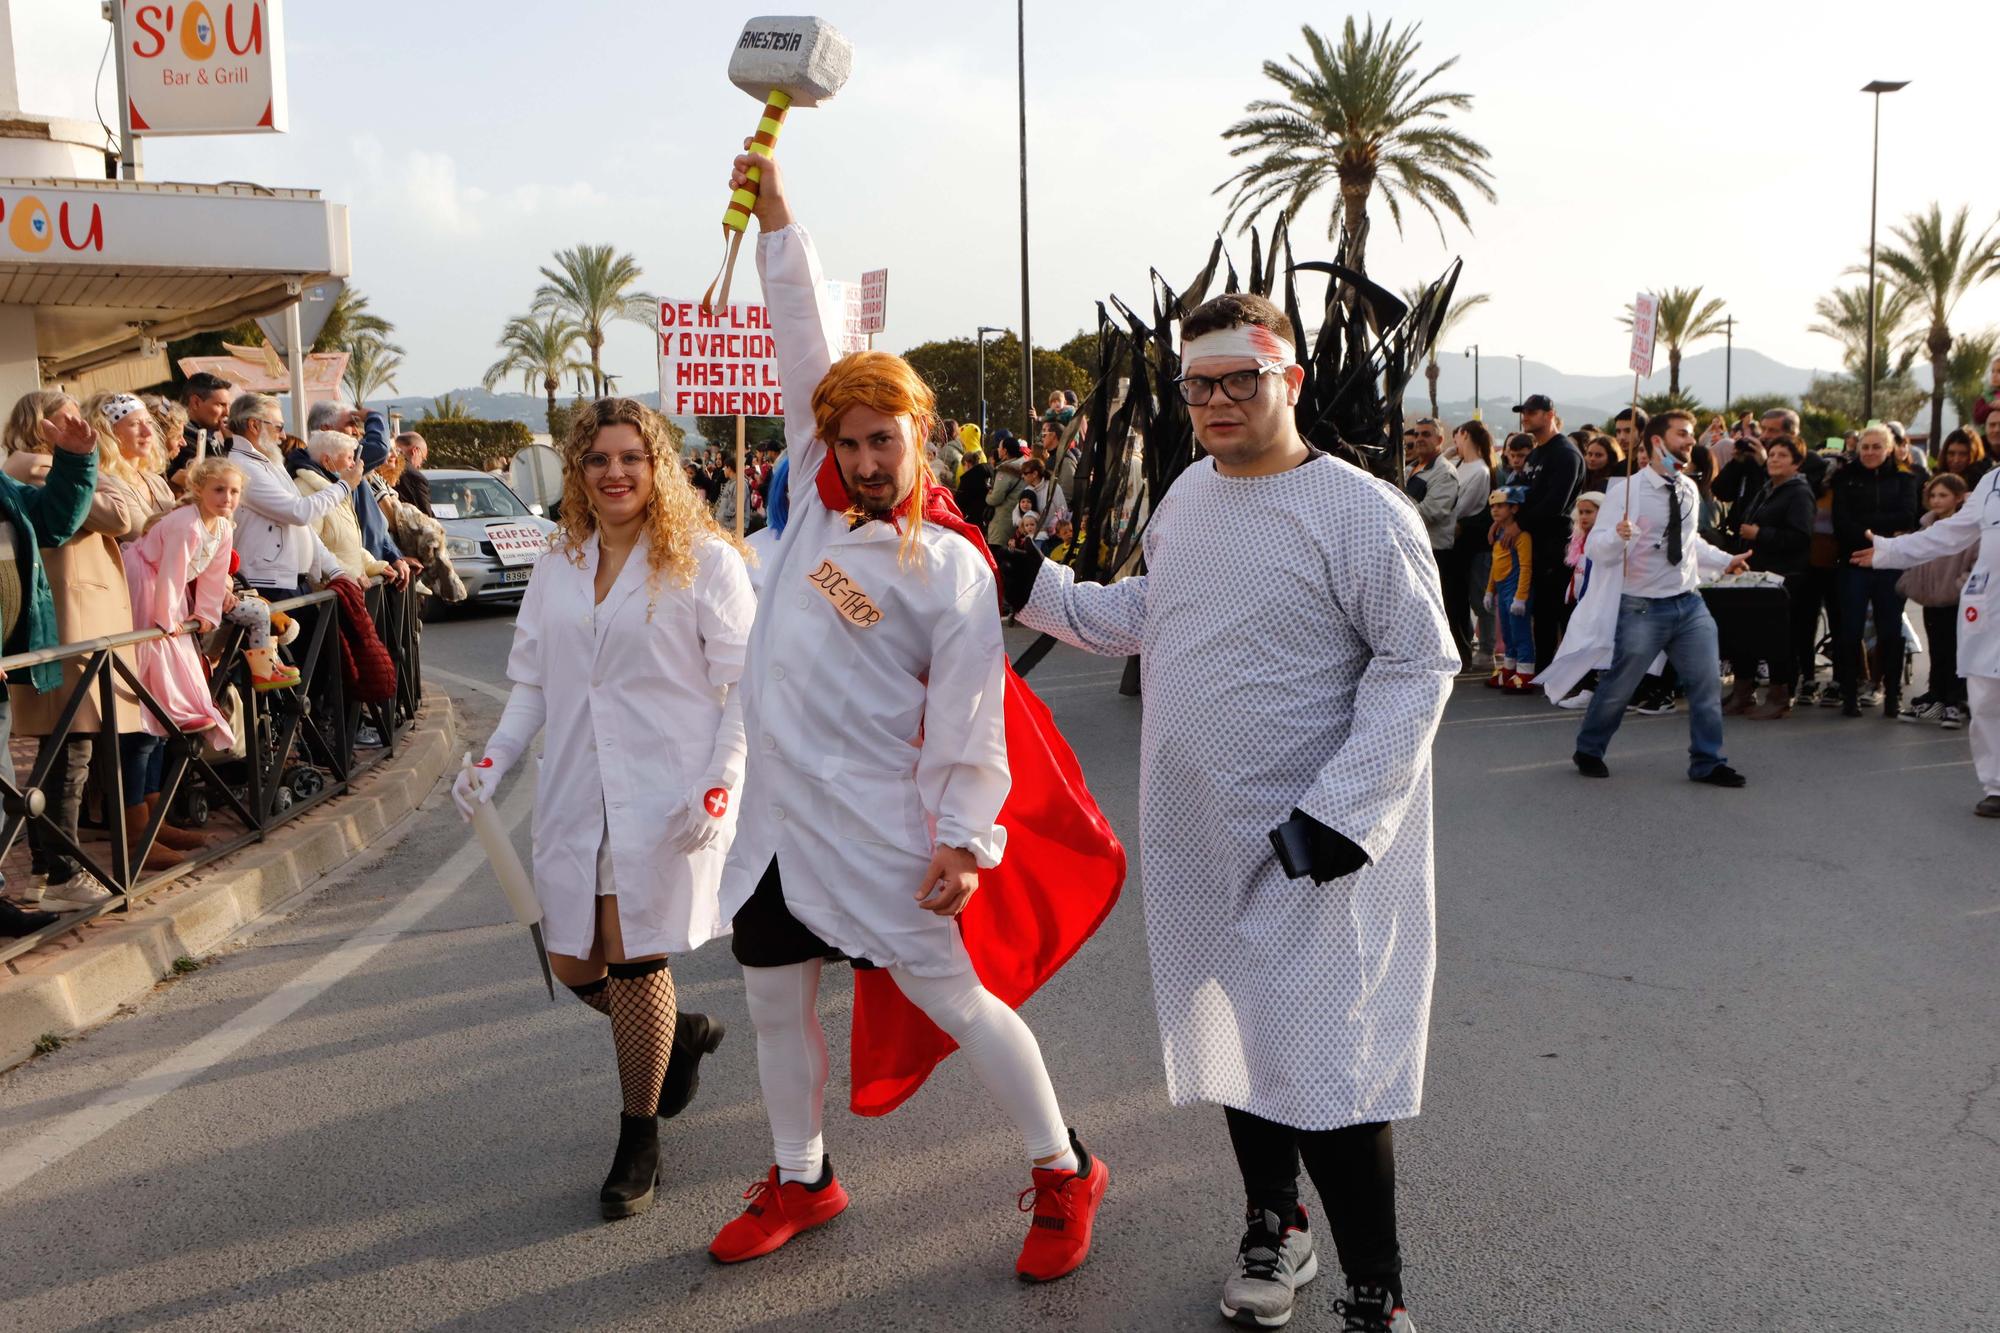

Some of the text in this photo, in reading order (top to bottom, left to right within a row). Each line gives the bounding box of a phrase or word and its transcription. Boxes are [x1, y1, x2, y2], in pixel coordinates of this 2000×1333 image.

[133, 1, 262, 61] S'OU
[163, 67, 248, 85] Bar & Grill
[661, 303, 693, 327] DE
[660, 332, 673, 356] Y
[677, 363, 782, 386] HASTA L
[809, 562, 880, 627] DOC-THOR
